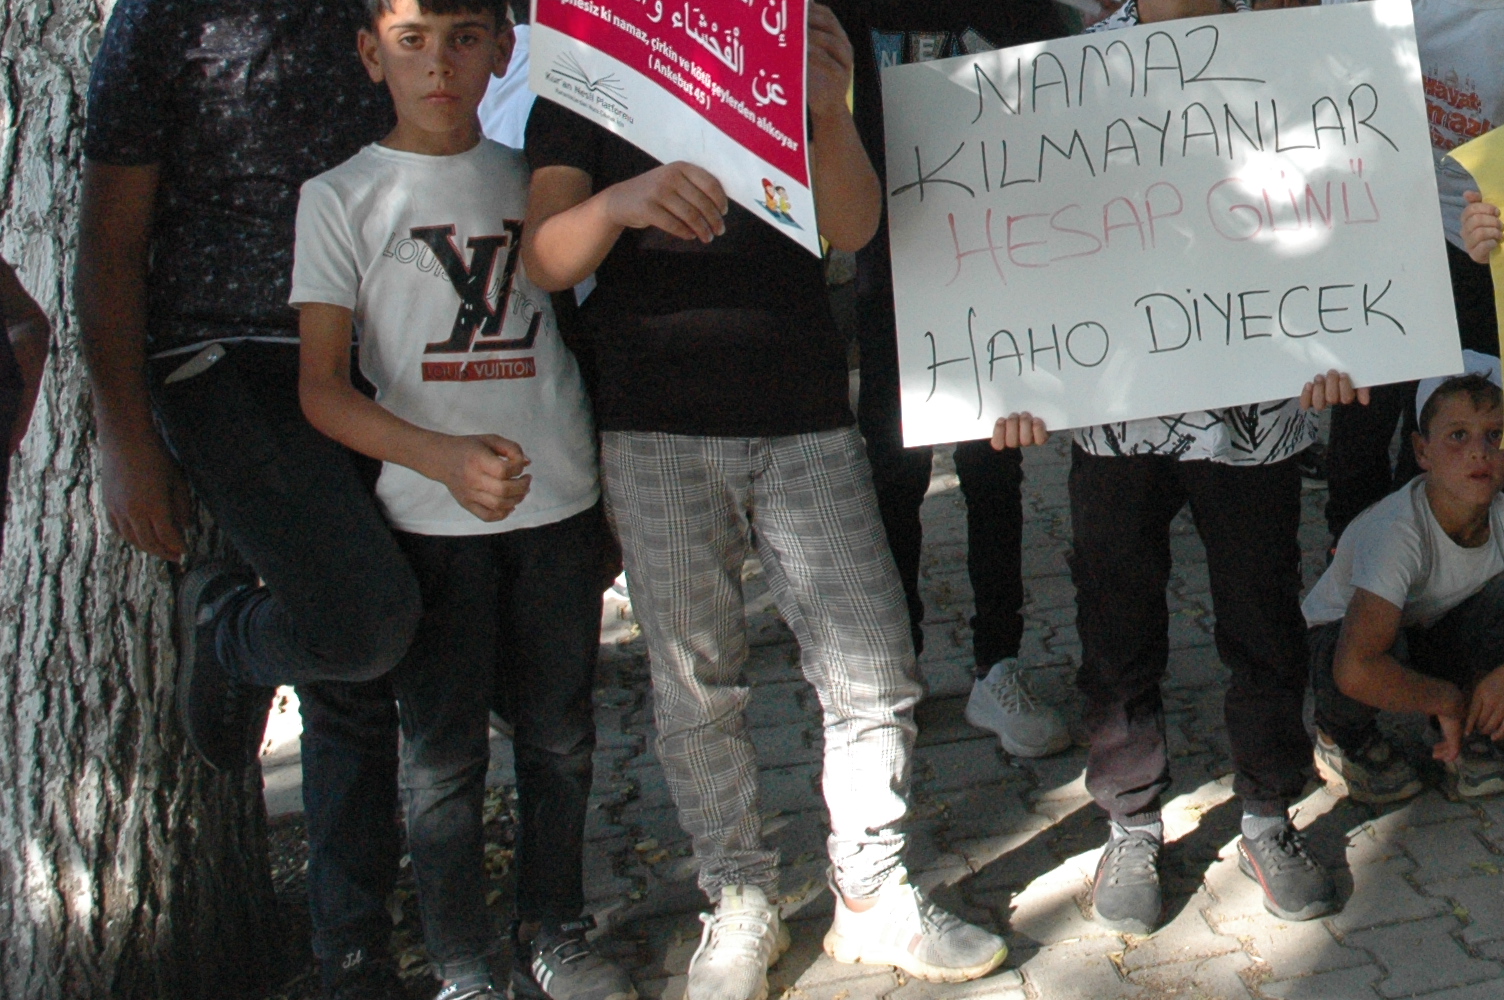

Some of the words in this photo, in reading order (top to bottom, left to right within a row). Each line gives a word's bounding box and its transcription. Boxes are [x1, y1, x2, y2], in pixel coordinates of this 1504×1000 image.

[600, 5, 612, 23] ki
[612, 15, 649, 46] namaz,
[650, 37, 678, 63] çirkin
[678, 56, 691, 72] ve
[690, 61, 712, 89] kötü
[711, 82, 757, 124] şeylerden
[756, 116, 799, 152] alıkoyar
[972, 25, 1265, 124] NAMAZ
[892, 83, 1399, 202] KILMAYANLAR
[946, 182, 1183, 286] HESAP
[1206, 157, 1381, 242] GÜNÜ
[474, 360, 535, 378] VUITTON
[925, 307, 1109, 420] HAHO
[1134, 279, 1406, 354] DİYECEK
